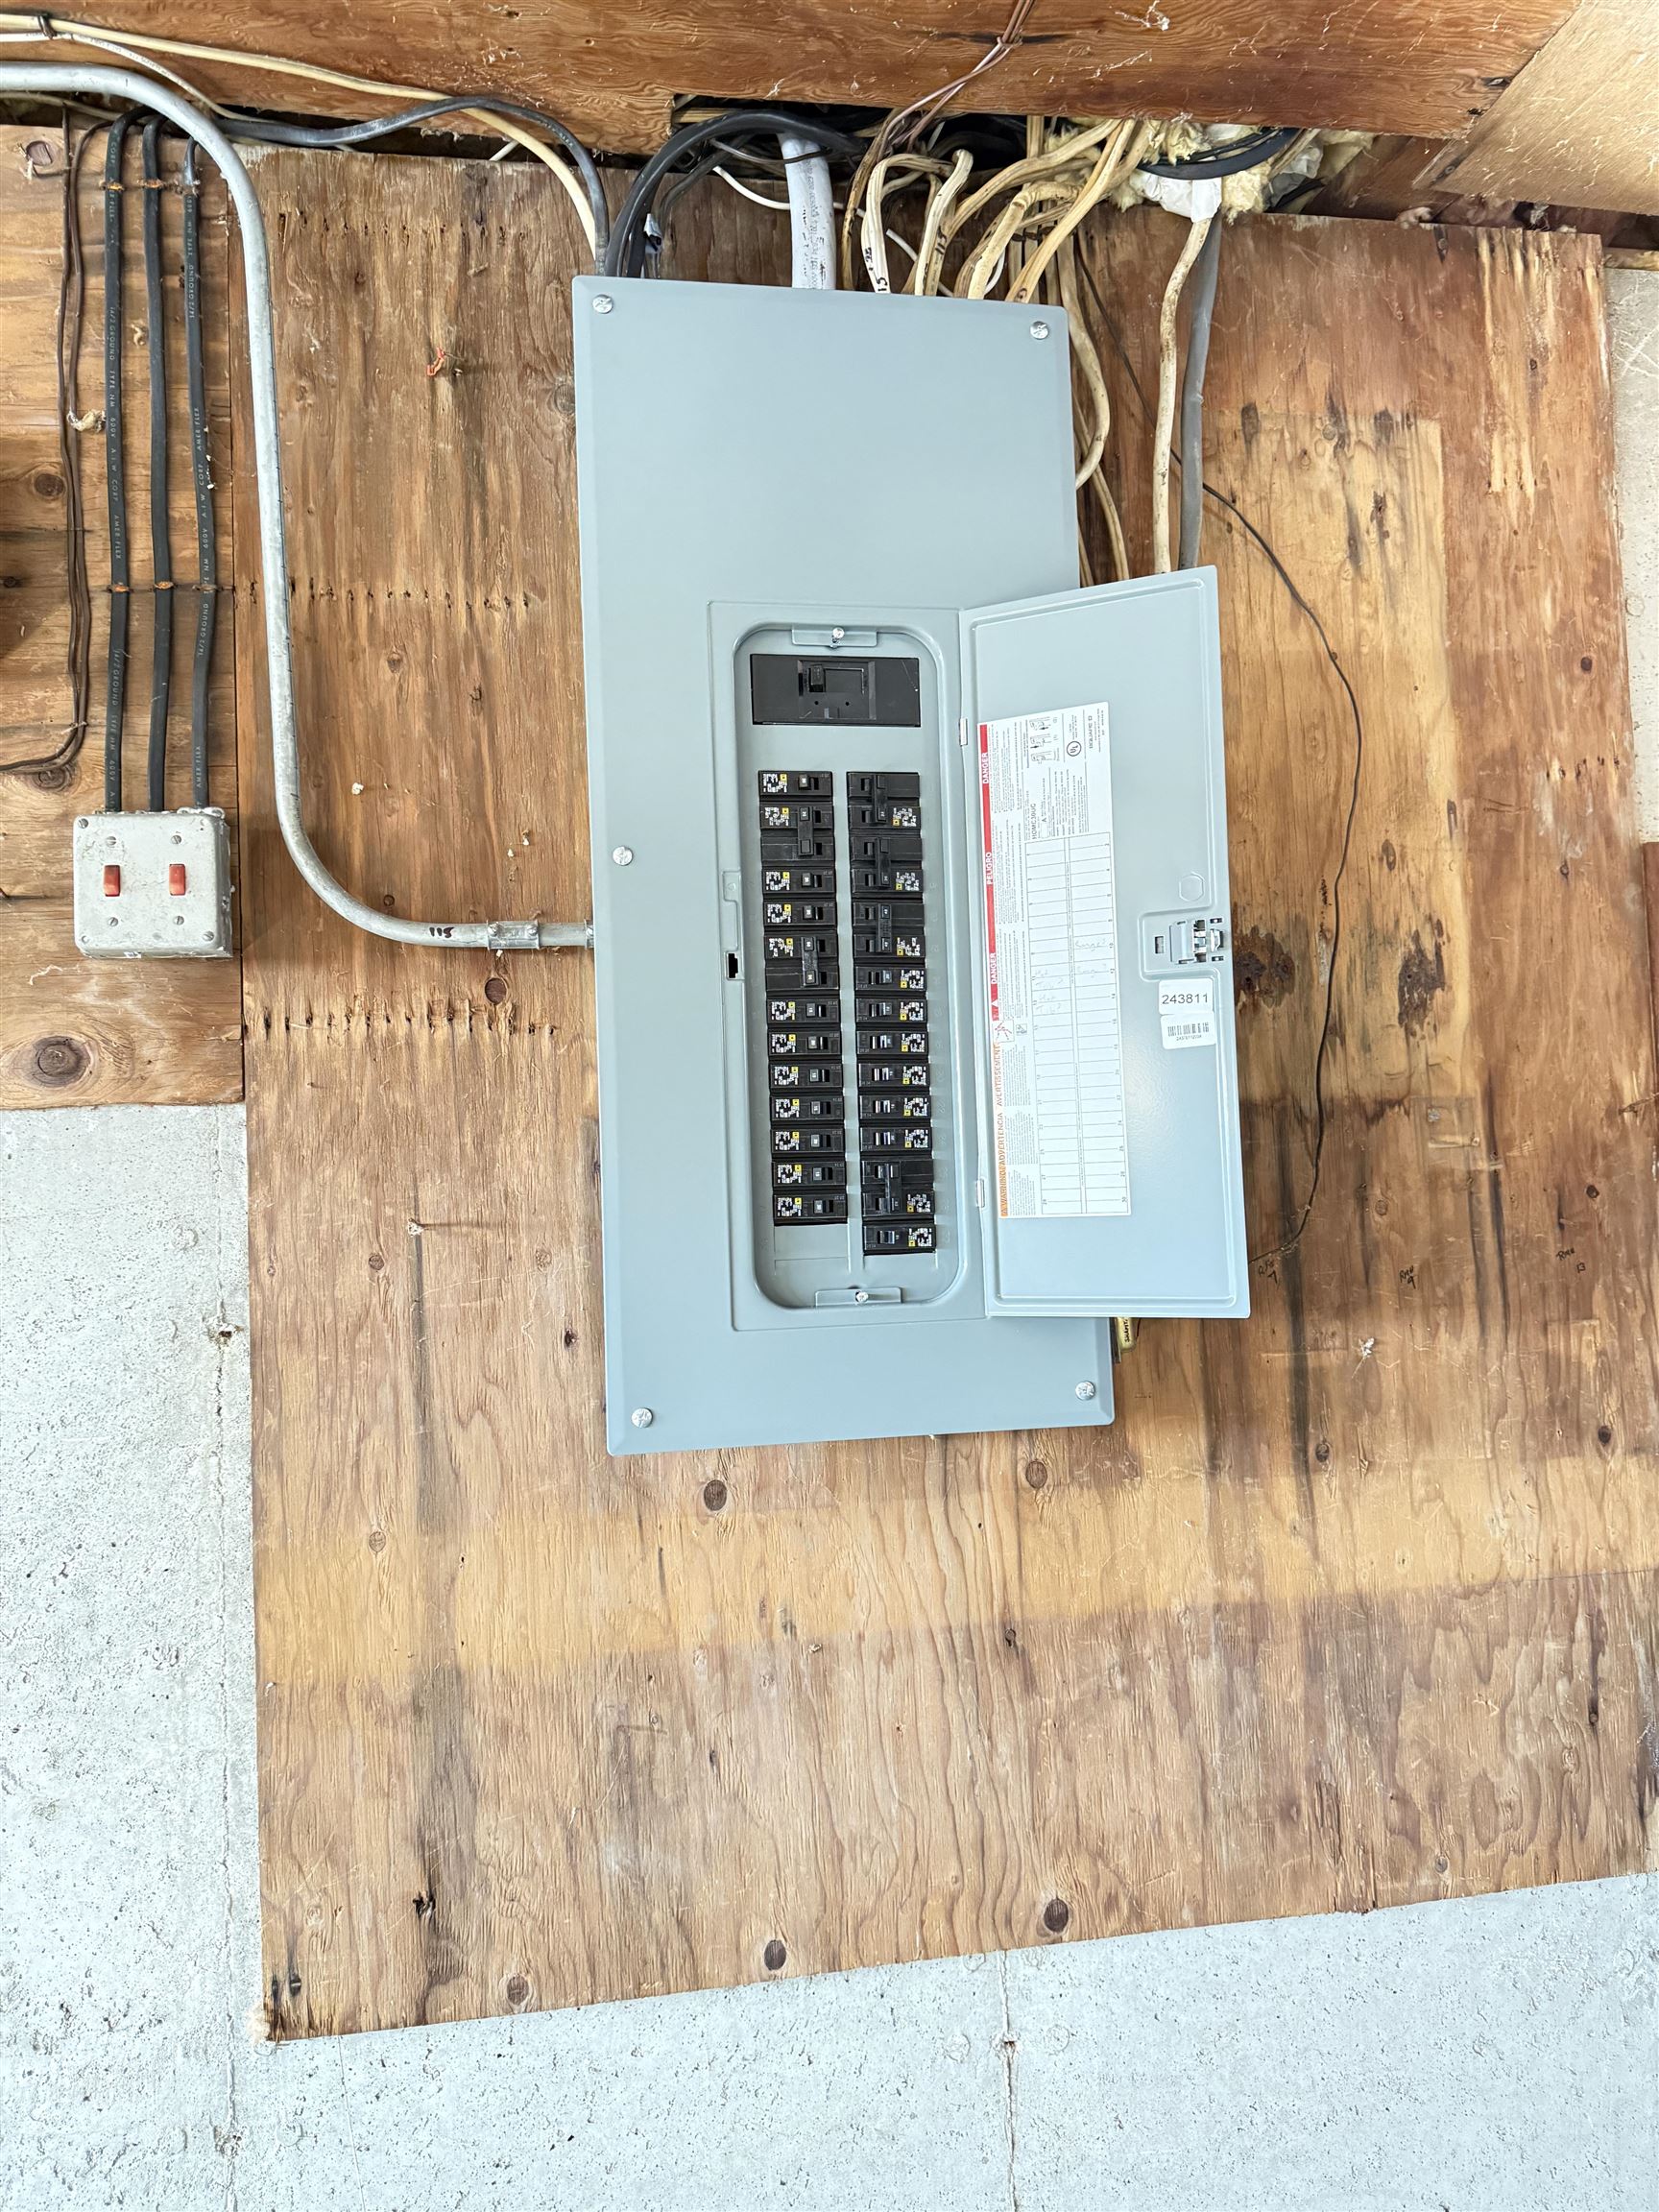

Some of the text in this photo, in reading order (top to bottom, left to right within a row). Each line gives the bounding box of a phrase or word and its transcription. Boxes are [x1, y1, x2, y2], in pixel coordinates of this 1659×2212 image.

[186, 221, 192, 233] NM
[109, 394, 116, 407] NM
[203, 558, 209, 571] NM
[985, 852, 994, 885] PELIGRO
[1162, 993, 1208, 1004] 243811
[994, 1045, 1002, 1106] AVERTISSEMENT
[997, 1112, 1005, 1166] ADVERTENCIA
